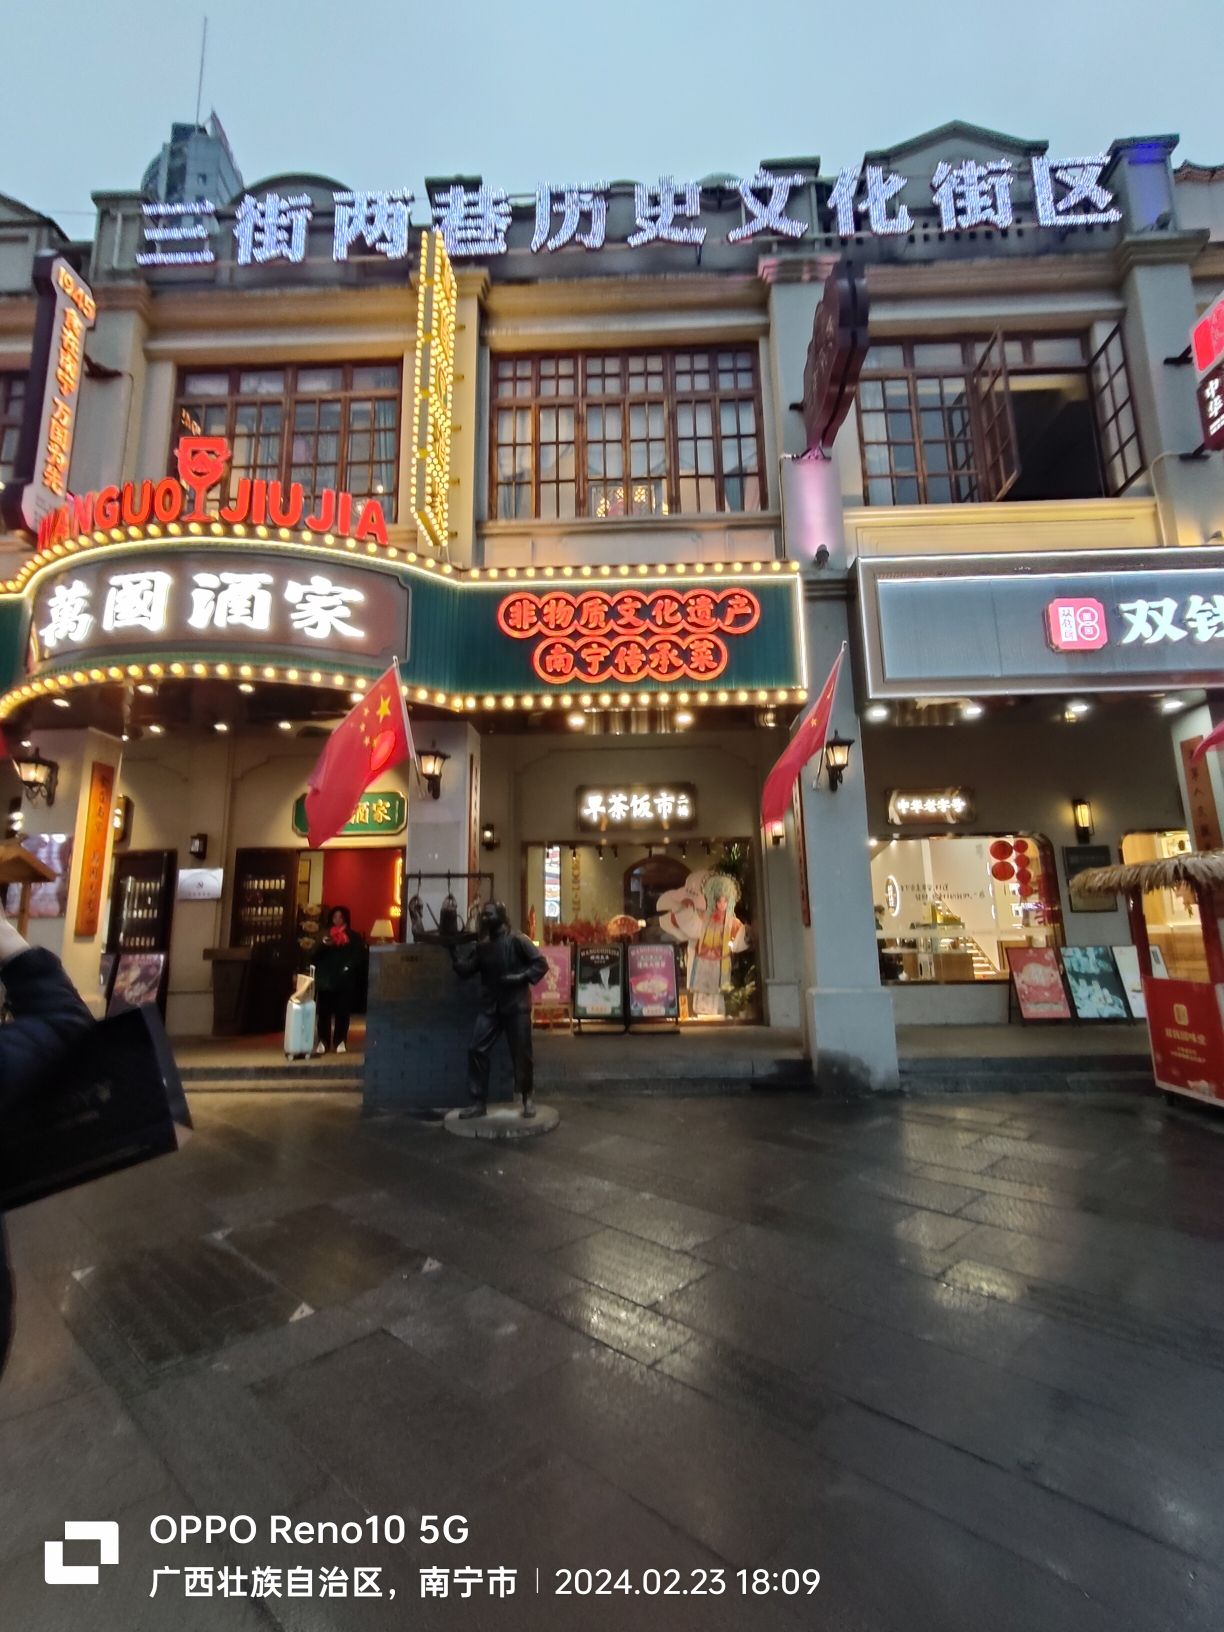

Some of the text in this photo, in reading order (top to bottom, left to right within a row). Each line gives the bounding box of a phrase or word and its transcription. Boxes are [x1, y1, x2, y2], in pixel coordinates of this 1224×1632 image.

[135, 154, 1122, 266] 三街两巷历史文化街区
[57, 265, 97, 323] 1945
[37, 478, 184, 550] WANGUO
[40, 570, 365, 647] 萬國酒家
[508, 594, 753, 630] 非物质文化遗产
[544, 638, 718, 675] 南宁传承菜
[583, 791, 675, 822] 早茶饭市
